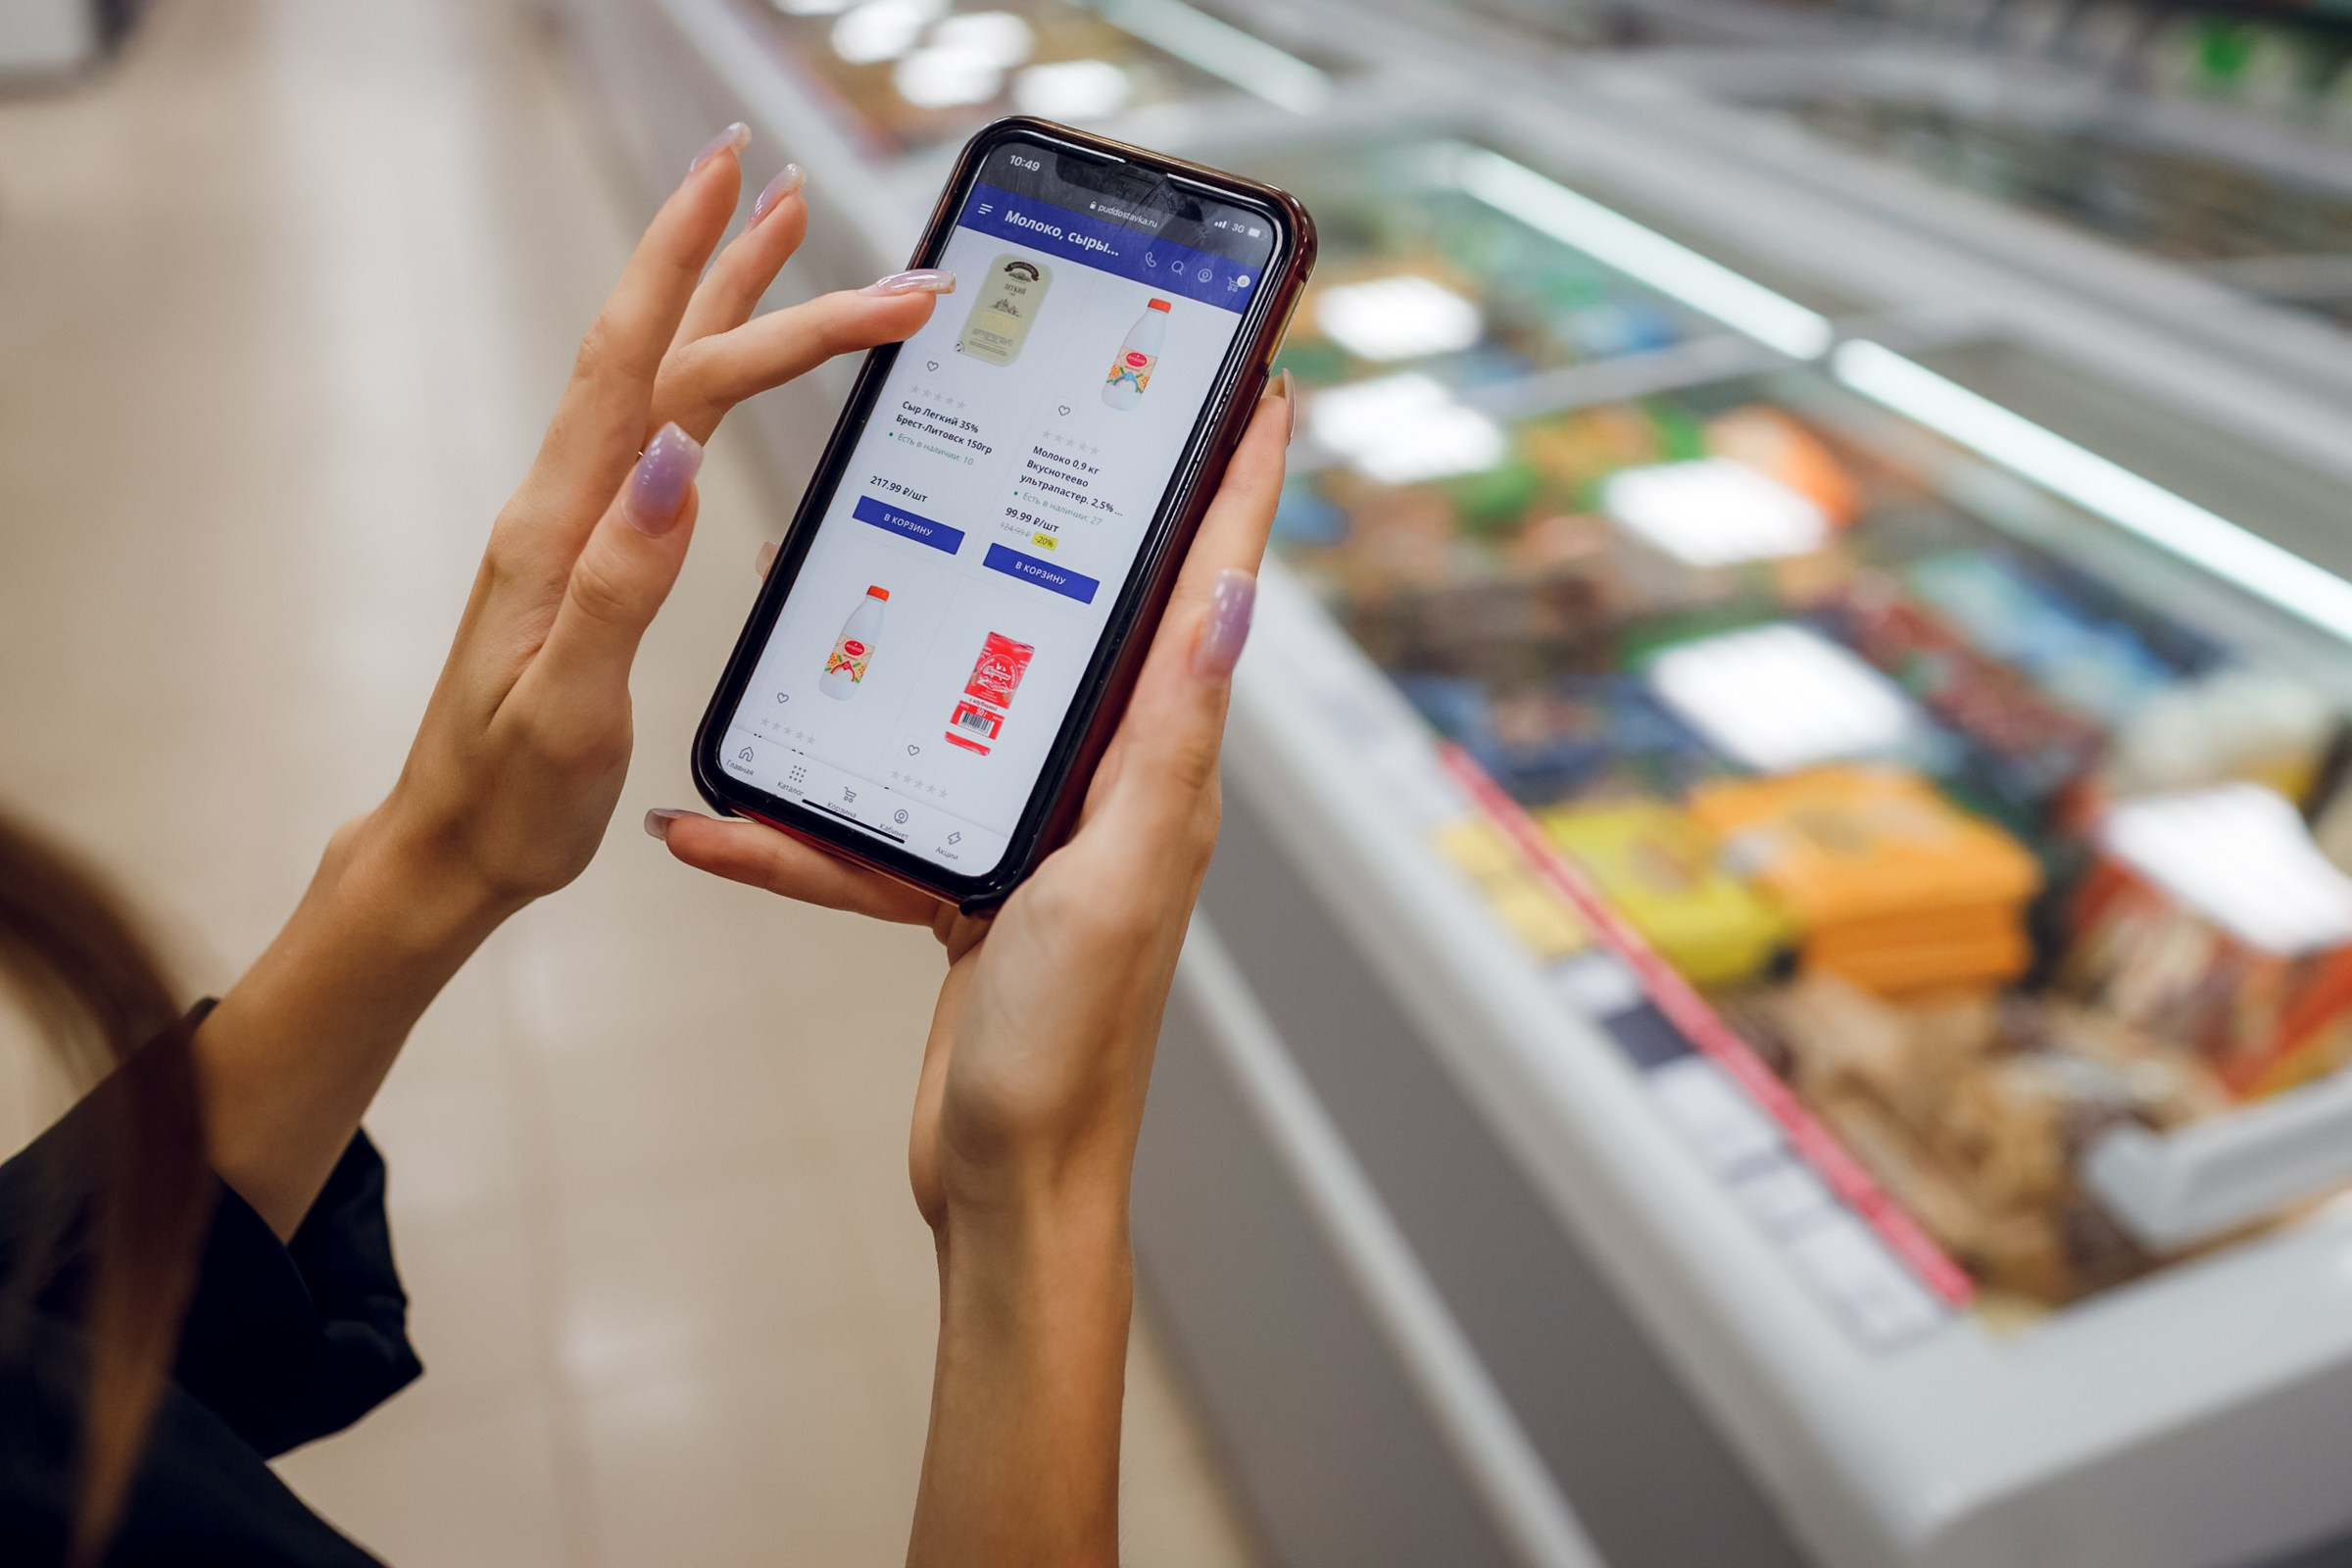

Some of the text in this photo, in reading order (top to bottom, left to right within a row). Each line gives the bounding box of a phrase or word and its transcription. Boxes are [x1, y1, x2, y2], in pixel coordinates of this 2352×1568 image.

[1008, 154, 1041, 172] 10:49
[1004, 210, 1064, 240] Молоко,
[1098, 203, 1158, 228] puddostavka.ru
[1231, 222, 1245, 234] 3G
[902, 400, 979, 433] Сыр Легкий 35%
[896, 414, 993, 456] Брест-Литовск 150гр
[897, 432, 915, 446] Есть
[923, 444, 962, 463] наличии:
[963, 456, 974, 466] 10
[1032, 446, 1101, 475] Молоко 0,9 кг
[870, 475, 902, 493] 217.99
[1026, 459, 1090, 488] Вкуснотеево
[1019, 473, 1089, 505] ультрапастер.
[1004, 506, 1032, 523] 99.99
[1022, 491, 1041, 506] Есть
[1050, 503, 1090, 521] наличии:
[1090, 515, 1102, 526] 27
[883, 513, 934, 537] В КОРЗИНУ
[1035, 535, 1054, 548] -20%
[1014, 561, 1067, 585] В КОРЗИНУ
[725, 759, 755, 776] Главная
[777, 780, 804, 797] Каталог
[827, 802, 857, 818] Корзина
[879, 822, 909, 841] Кабинет
[935, 846, 959, 861] Акции
